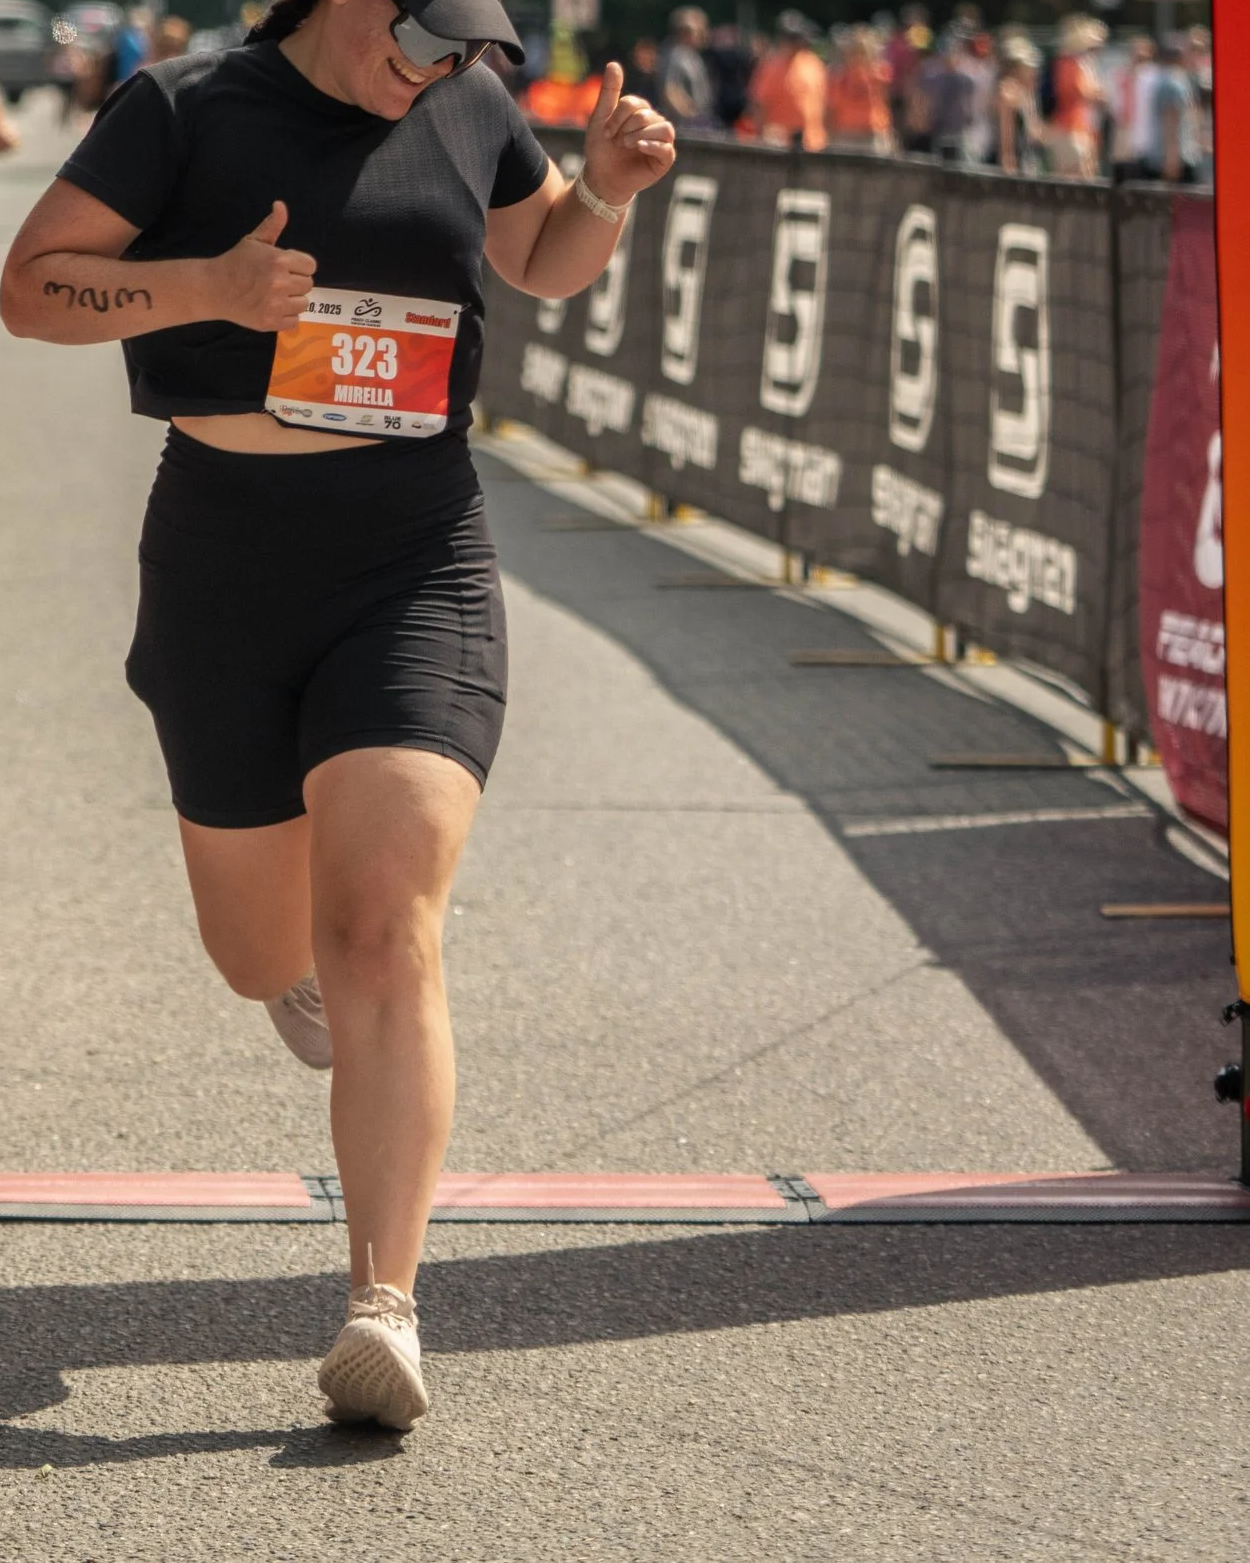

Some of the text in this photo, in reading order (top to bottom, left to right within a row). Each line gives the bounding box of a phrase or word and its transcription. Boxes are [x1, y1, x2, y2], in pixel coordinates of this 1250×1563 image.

[318, 302, 342, 315] 2025
[405, 311, 452, 329] Standard
[331, 332, 398, 380] 323
[334, 384, 394, 407] MIRELLA
[384, 421, 401, 430] 70
